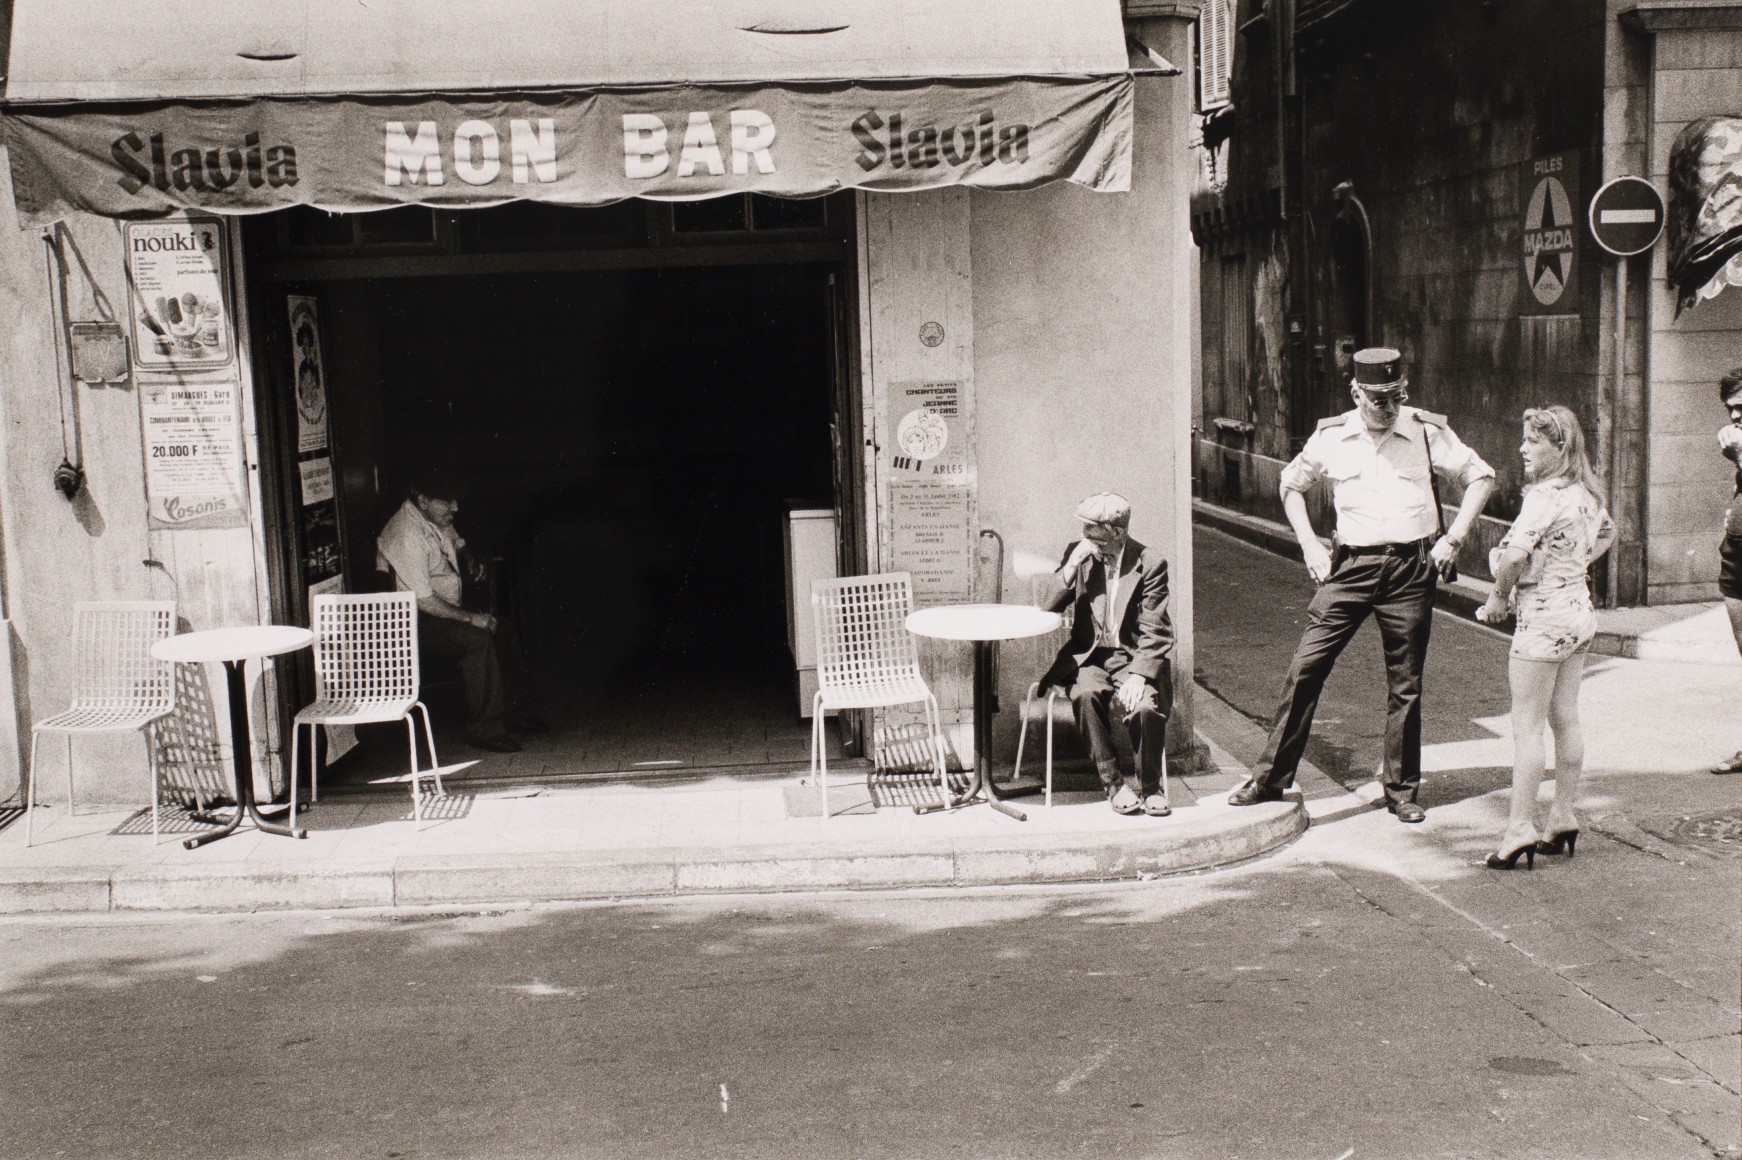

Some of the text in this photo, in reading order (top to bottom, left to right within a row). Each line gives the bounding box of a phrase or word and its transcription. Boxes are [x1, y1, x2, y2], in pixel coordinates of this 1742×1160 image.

[384, 109, 776, 187] MON BAR
[851, 108, 1030, 172] Slavia
[111, 130, 299, 196] Slavia
[1533, 156, 1563, 176] PILES
[133, 231, 197, 253] nouki
[1524, 228, 1574, 254] MAZDA
[906, 387, 957, 395] CHANTEURS
[152, 444, 198, 459] 20.000 F
[933, 464, 963, 475] ARLES
